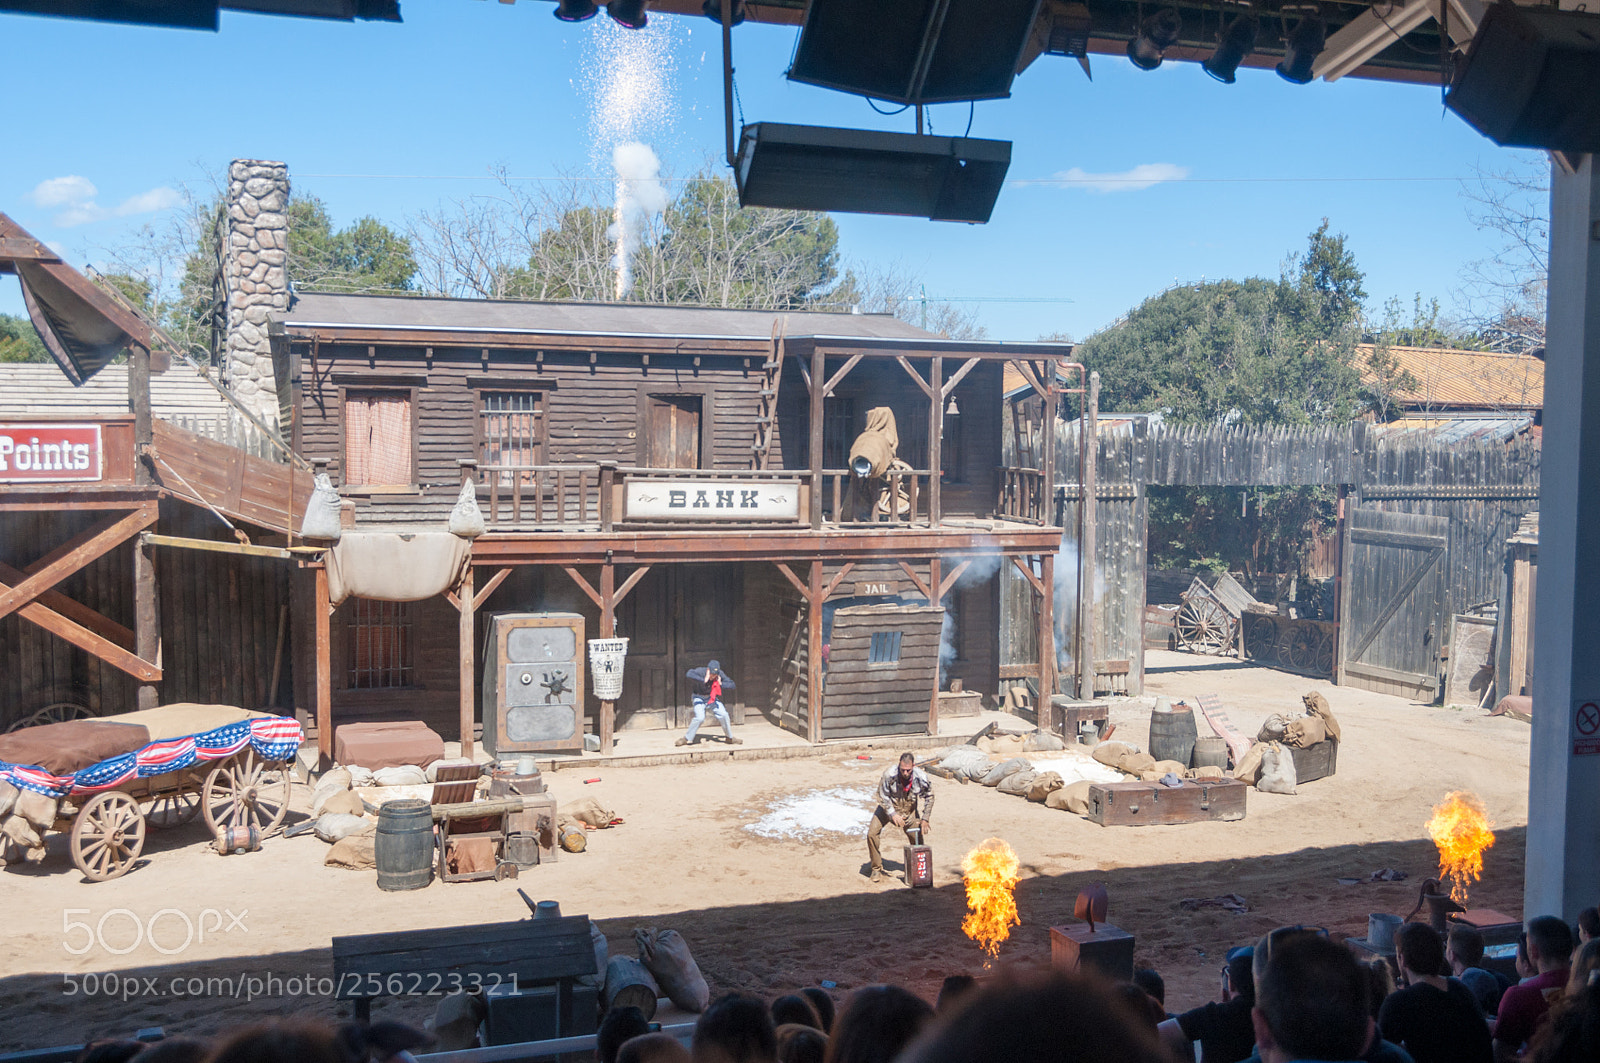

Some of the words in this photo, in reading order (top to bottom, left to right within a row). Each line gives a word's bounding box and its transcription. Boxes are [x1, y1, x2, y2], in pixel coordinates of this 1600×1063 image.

[0, 436, 90, 471] Points
[669, 490, 759, 508] BANK
[864, 583, 889, 594] JAIL
[594, 643, 624, 652] WANTED
